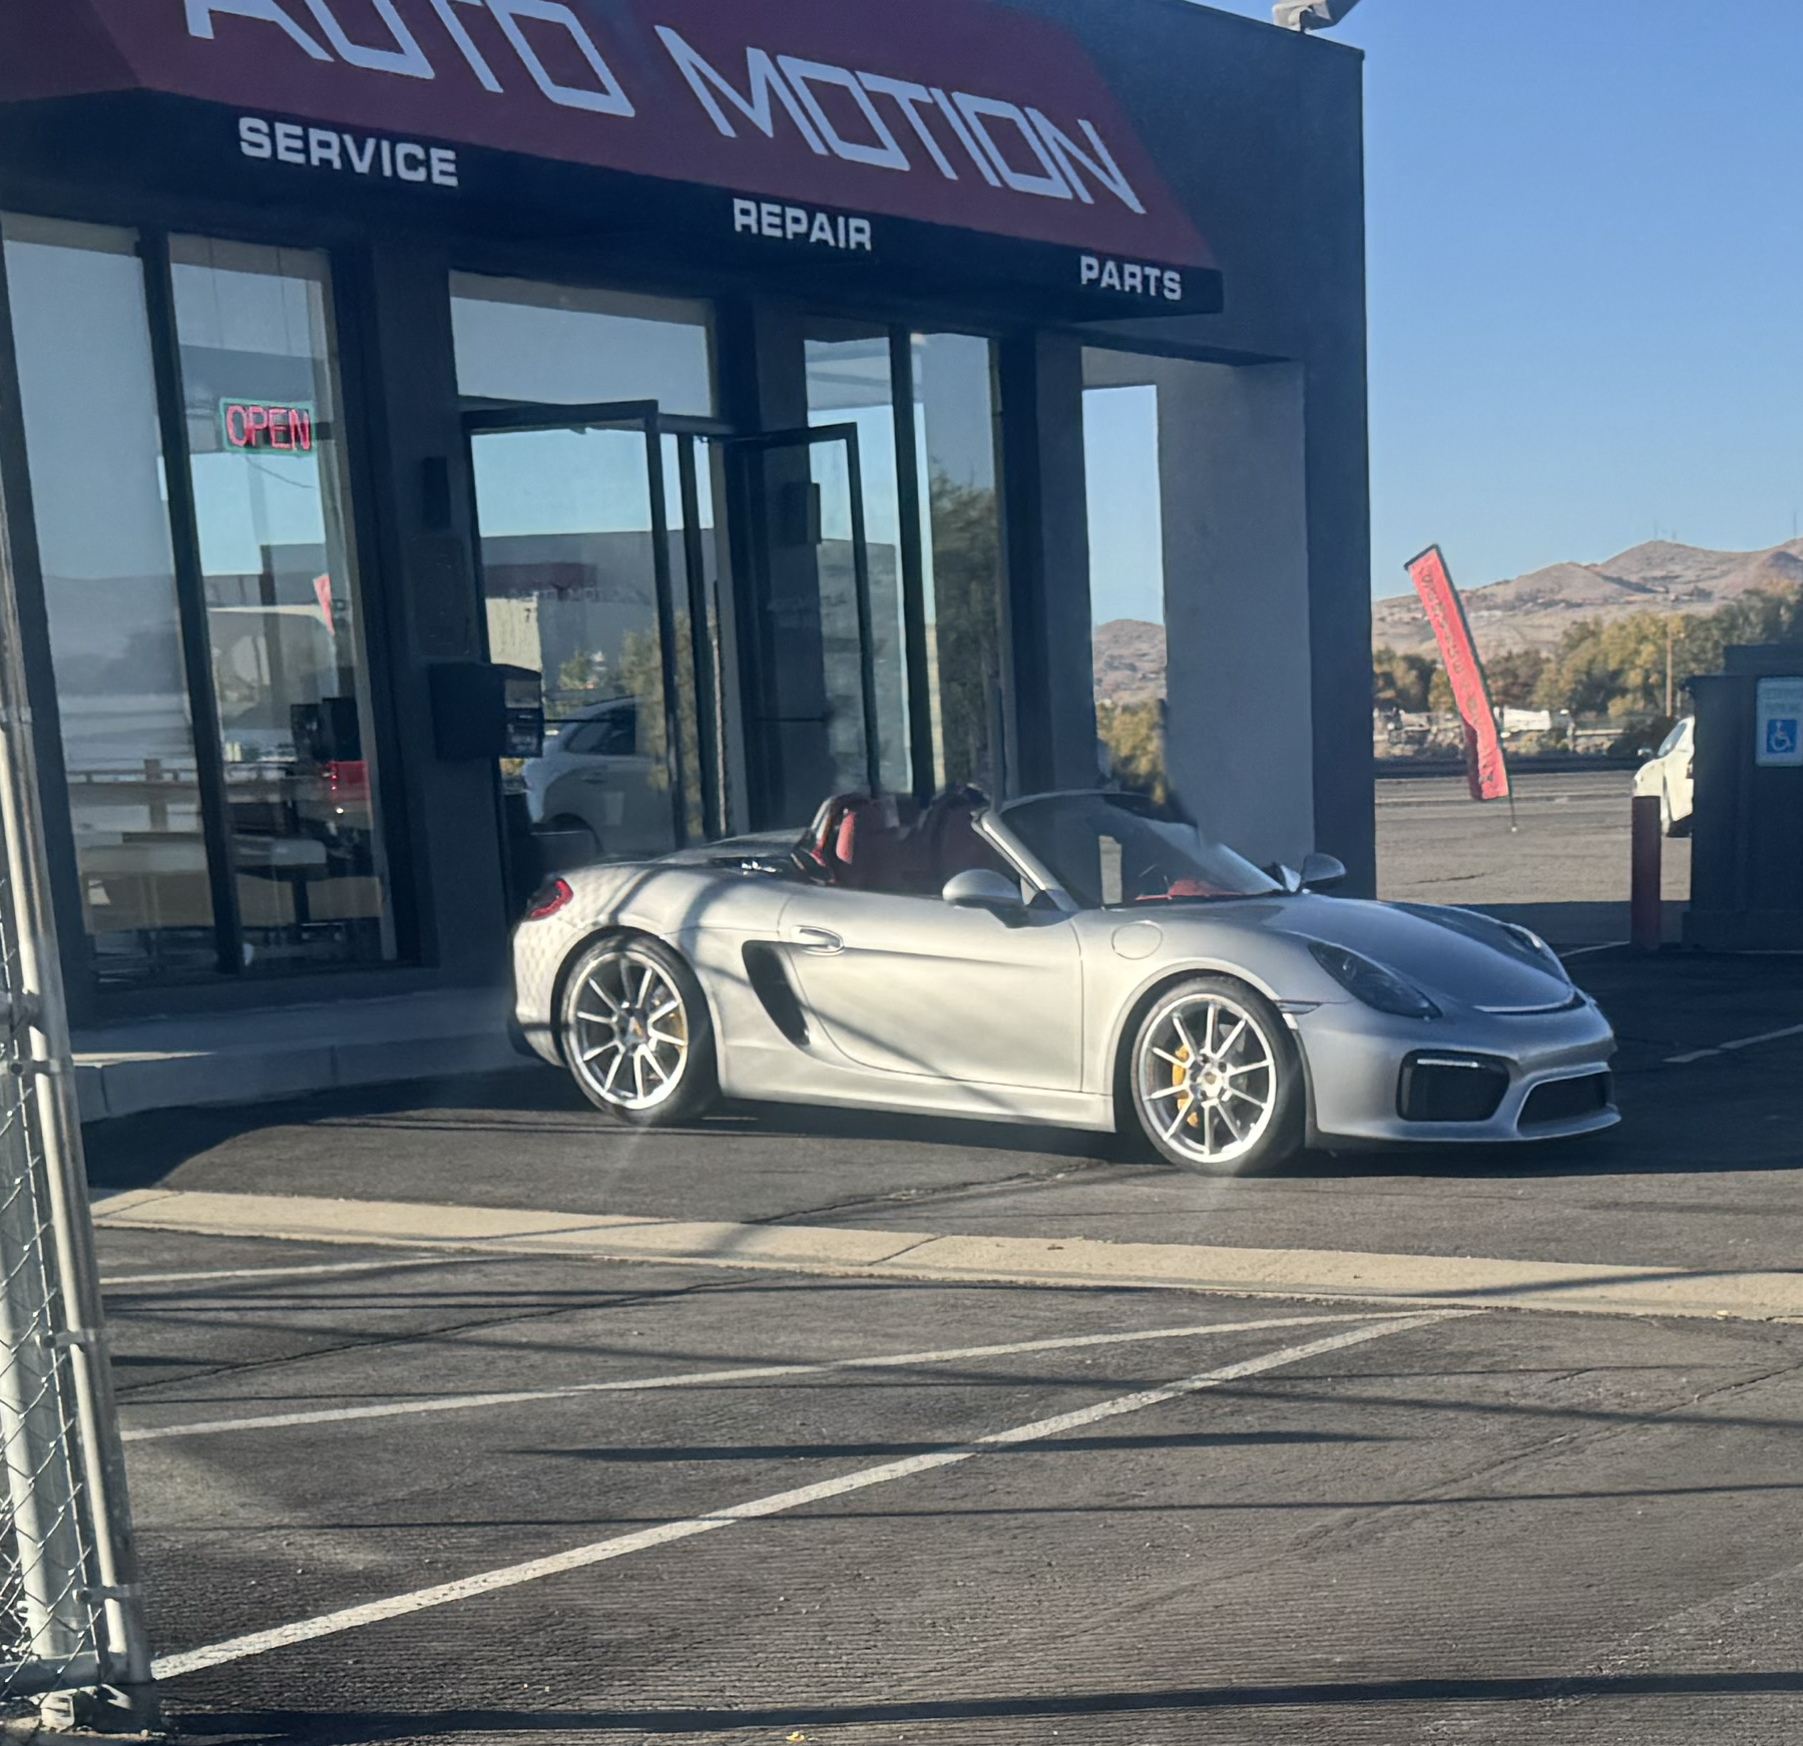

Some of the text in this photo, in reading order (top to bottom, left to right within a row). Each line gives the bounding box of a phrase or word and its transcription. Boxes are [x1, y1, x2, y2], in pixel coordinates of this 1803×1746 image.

[239, 117, 1182, 301] SERVICE REPAIR PARTS
[654, 24, 1147, 215] MOTION
[225, 404, 312, 451] OPEN
